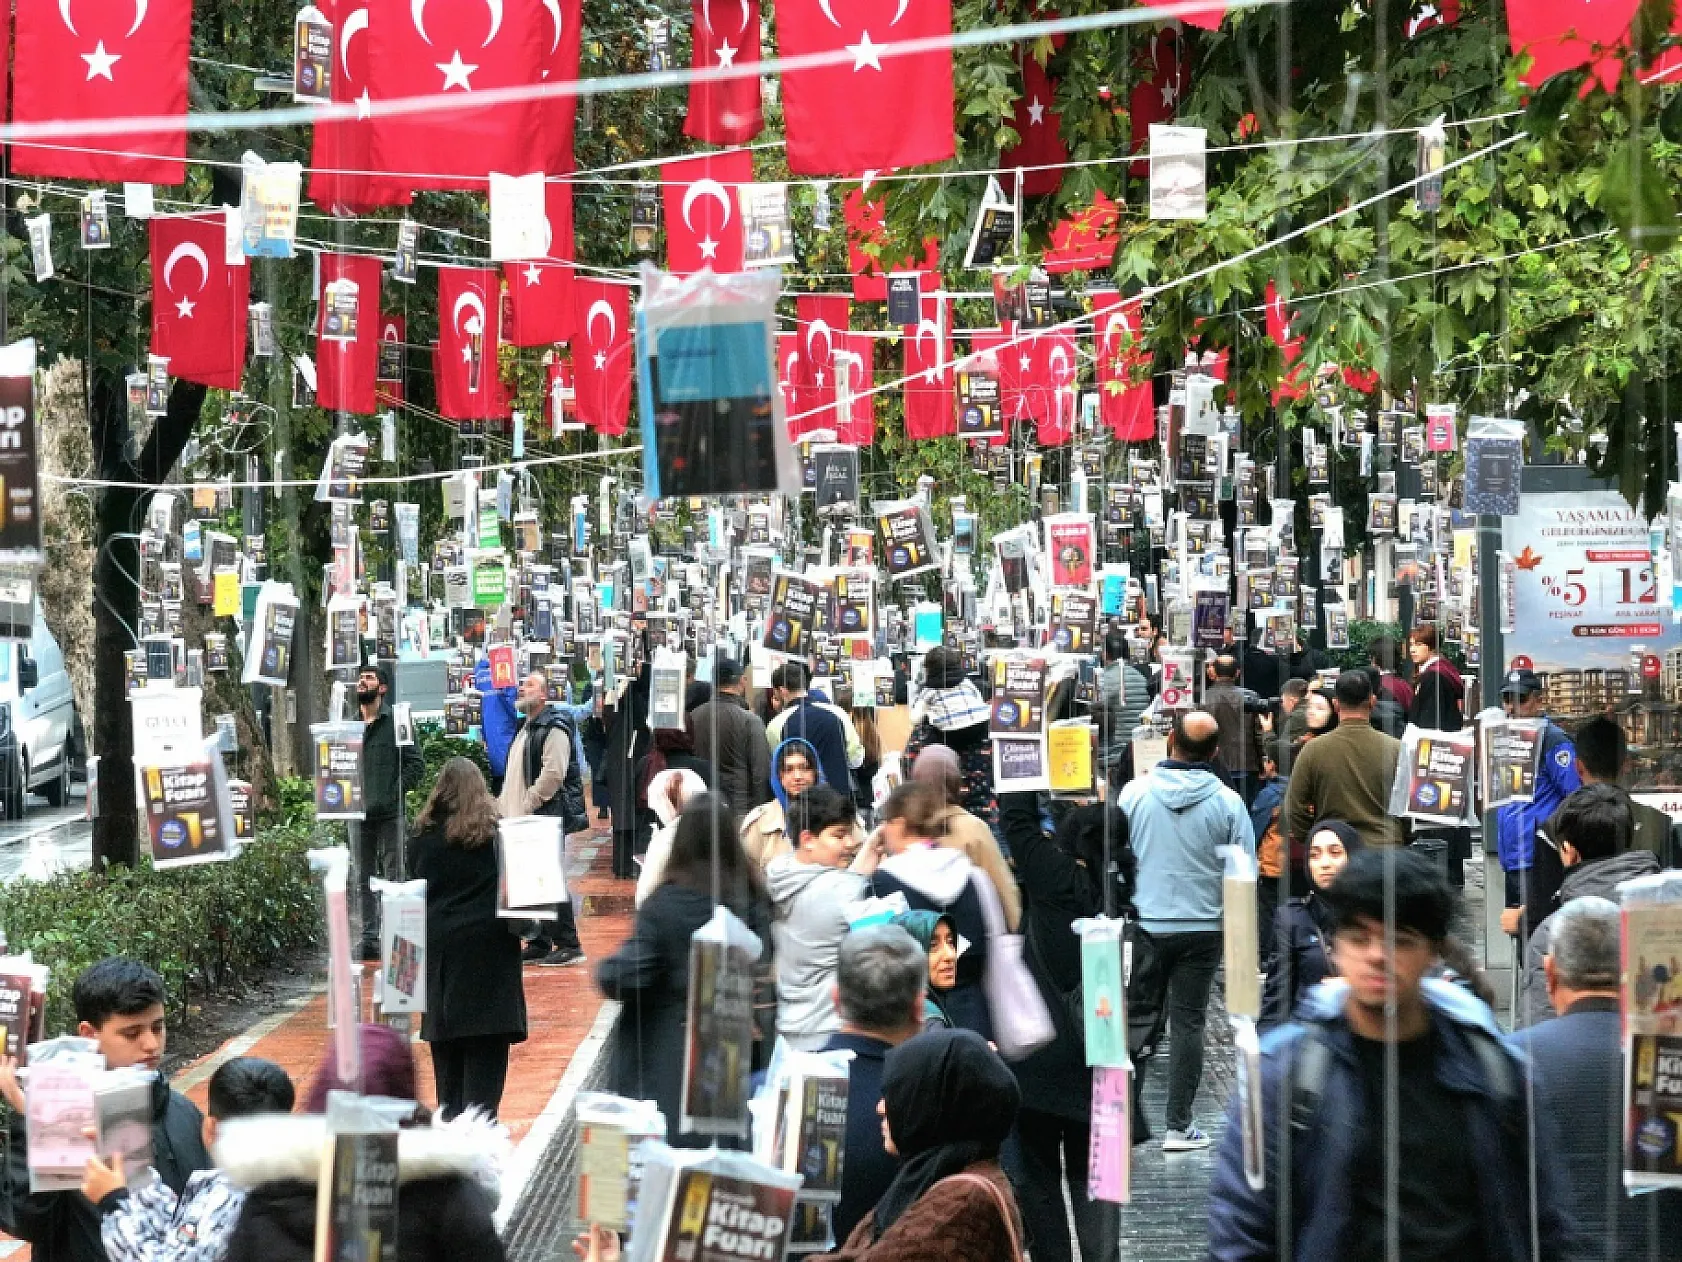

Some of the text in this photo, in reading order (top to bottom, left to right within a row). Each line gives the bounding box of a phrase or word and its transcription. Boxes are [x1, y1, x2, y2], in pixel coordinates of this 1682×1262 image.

[1557, 510, 1622, 525] YAŞAMA
[1541, 567, 1587, 606] %5
[1616, 567, 1657, 604] 12
[709, 1200, 785, 1239] Kitap
